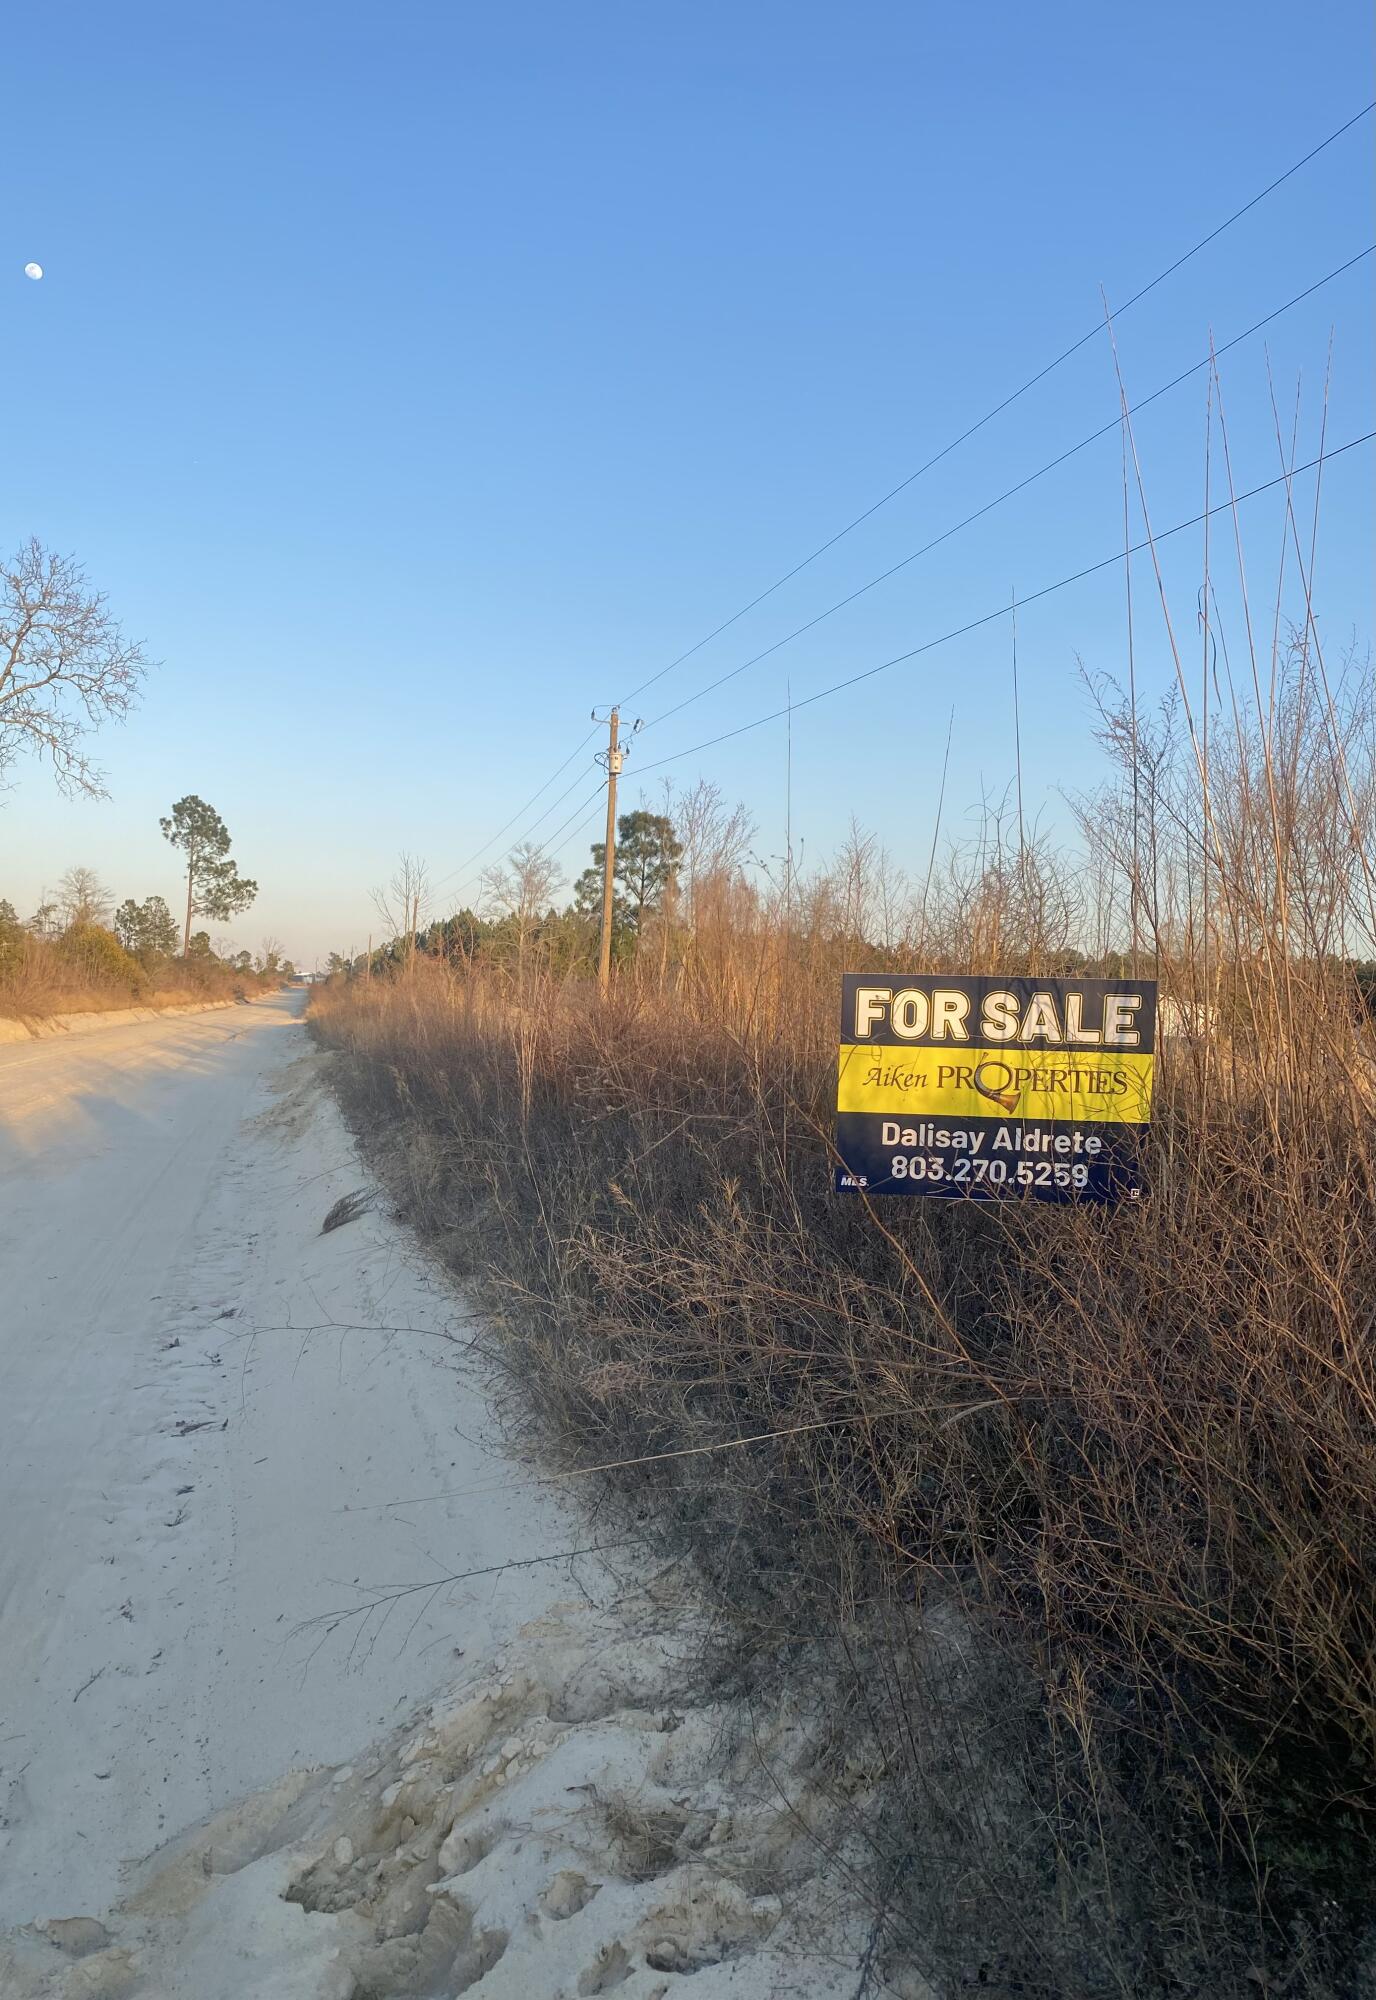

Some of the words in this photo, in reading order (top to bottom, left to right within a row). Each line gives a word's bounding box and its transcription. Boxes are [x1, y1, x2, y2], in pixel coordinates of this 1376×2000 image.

[854, 987, 971, 1042] FOR
[979, 990, 1142, 1046] SALE
[862, 1063, 928, 1092] Aiken
[936, 1057, 1128, 1108] PROPERTIES
[881, 1122, 985, 1155] Dalisay
[992, 1125, 1102, 1155] Aldrete
[891, 1155, 1089, 1188] 803.270.5259
